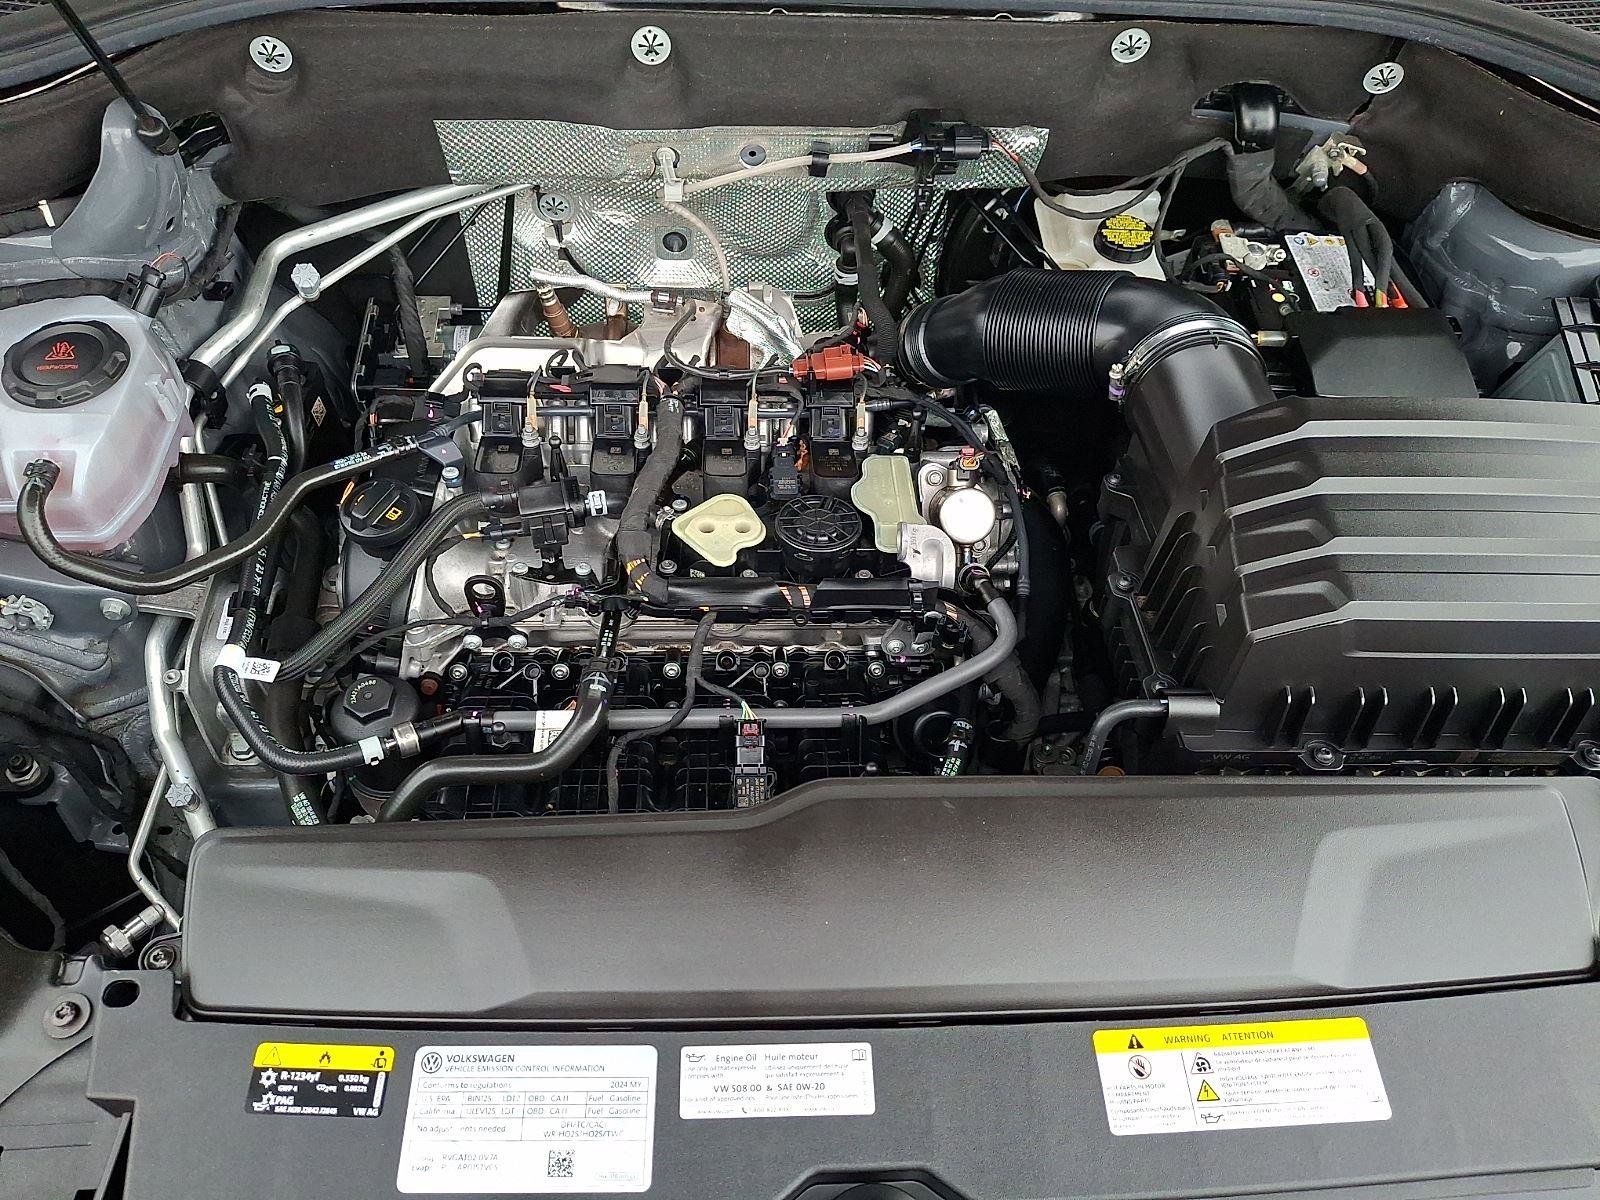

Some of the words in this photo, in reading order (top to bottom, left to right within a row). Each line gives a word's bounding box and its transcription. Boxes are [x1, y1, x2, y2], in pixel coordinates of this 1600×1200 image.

[1163, 1033, 1211, 1044] WARNING
[1222, 1030, 1275, 1042] ATTENTION
[446, 1054, 516, 1063] VOLKSWAGEN
[715, 1054, 744, 1064] Engine
[745, 1053, 757, 1062] Oil
[553, 1064, 606, 1072] INFORMATION
[610, 1080, 628, 1089] 2024
[713, 1085, 730, 1093] VW
[478, 1125, 506, 1133] needed
